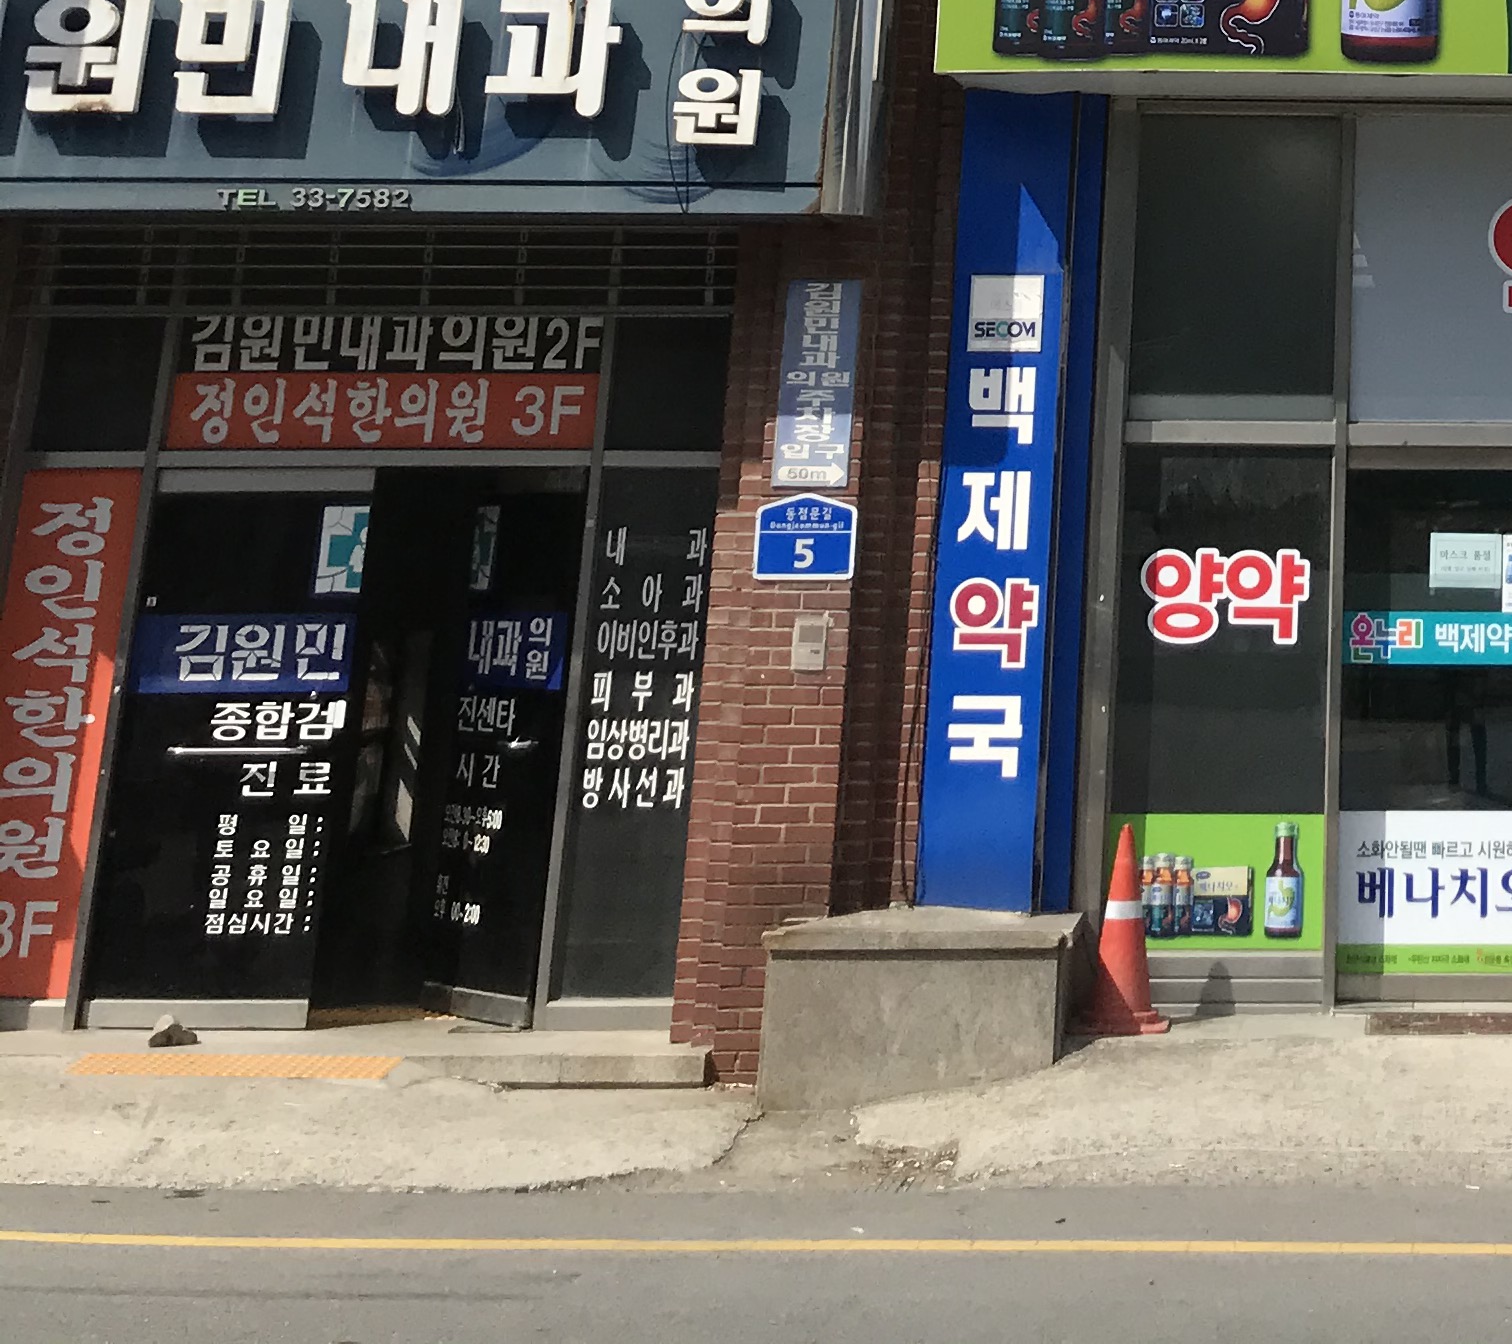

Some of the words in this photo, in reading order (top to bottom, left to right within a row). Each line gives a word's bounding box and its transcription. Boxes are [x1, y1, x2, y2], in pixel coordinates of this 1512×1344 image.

[215, 187, 277, 208] TEL
[974, 320, 1037, 340] SECOM
[189, 378, 490, 445] 정인석한의원
[510, 384, 586, 437] 3F
[792, 537, 816, 570] 5
[946, 366, 1041, 779] 백제약국
[1141, 547, 1311, 646] 양약
[175, 622, 347, 682] 김원민
[467, 619, 523, 677] 내과
[525, 616, 554, 681] 의원
[596, 619, 700, 662] 이비인후과
[1349, 612, 1424, 664] 온누리
[0, 496, 115, 880] 정인석한의원
[457, 695, 516, 737] 진센타
[586, 718, 690, 763] 임상병리과
